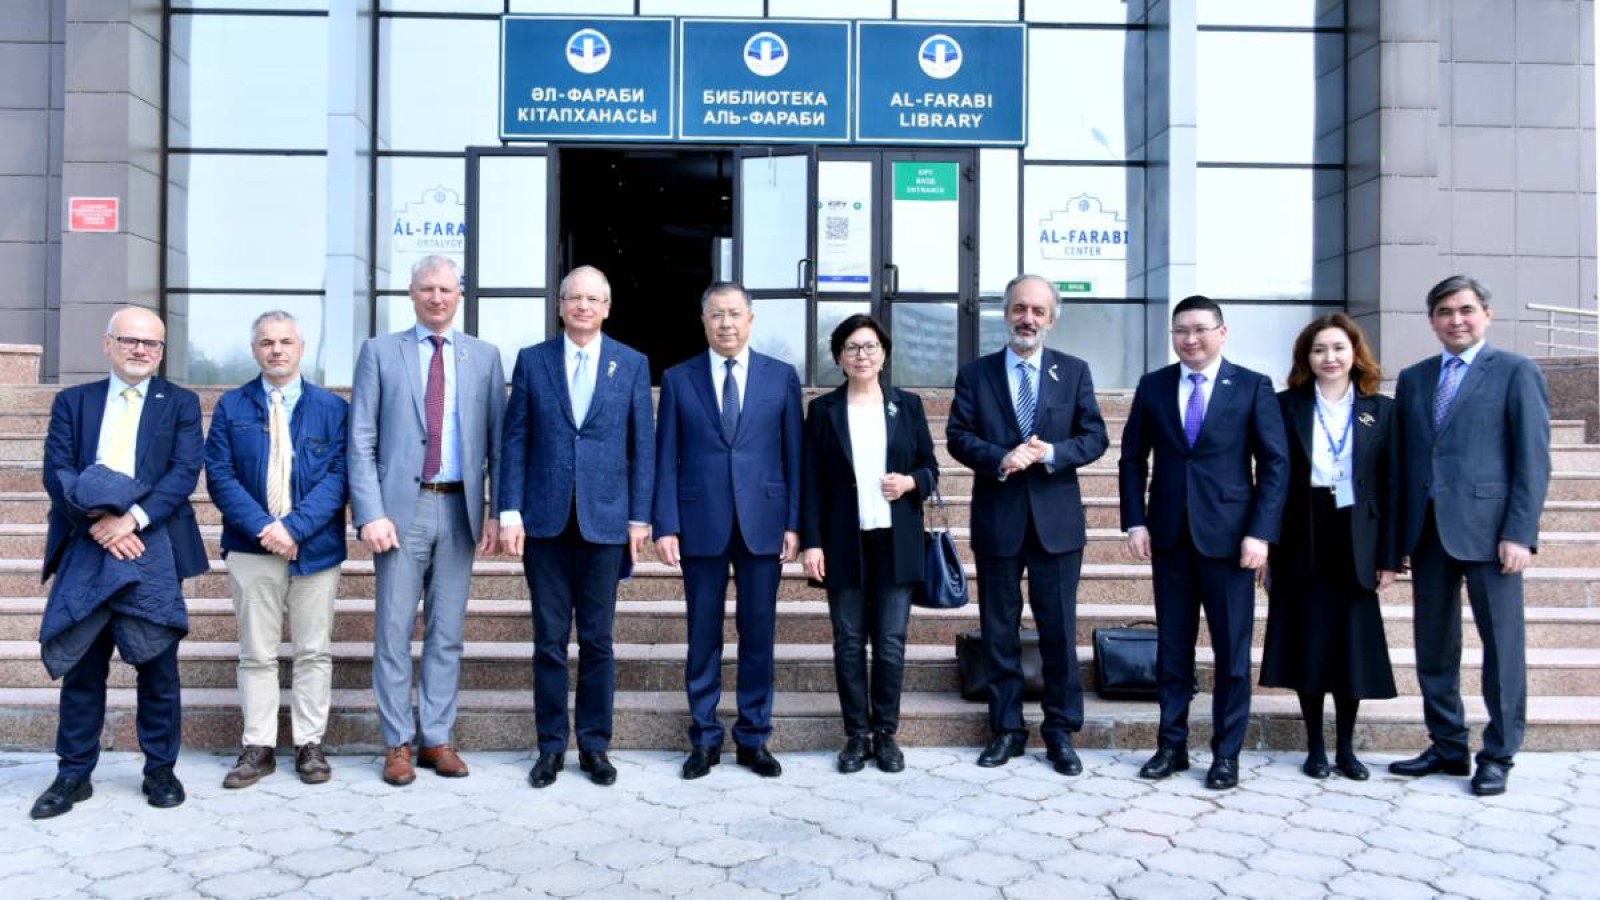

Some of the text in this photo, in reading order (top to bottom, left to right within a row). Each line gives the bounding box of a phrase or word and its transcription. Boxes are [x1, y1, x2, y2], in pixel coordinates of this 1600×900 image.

[531, 87, 645, 102] ӘЛ-ФАРАБИ
[703, 89, 827, 106] БИБЛИОТЕКА
[890, 92, 993, 108] AL-FARABI
[517, 107, 657, 124] КІТАПХАНАСЫ
[703, 110, 826, 127] АЛЬ-ФАРАБИ
[900, 112, 983, 128] LIBRARY
[1039, 229, 1129, 244] AL-FARABI
[1064, 246, 1101, 256] CENTER
